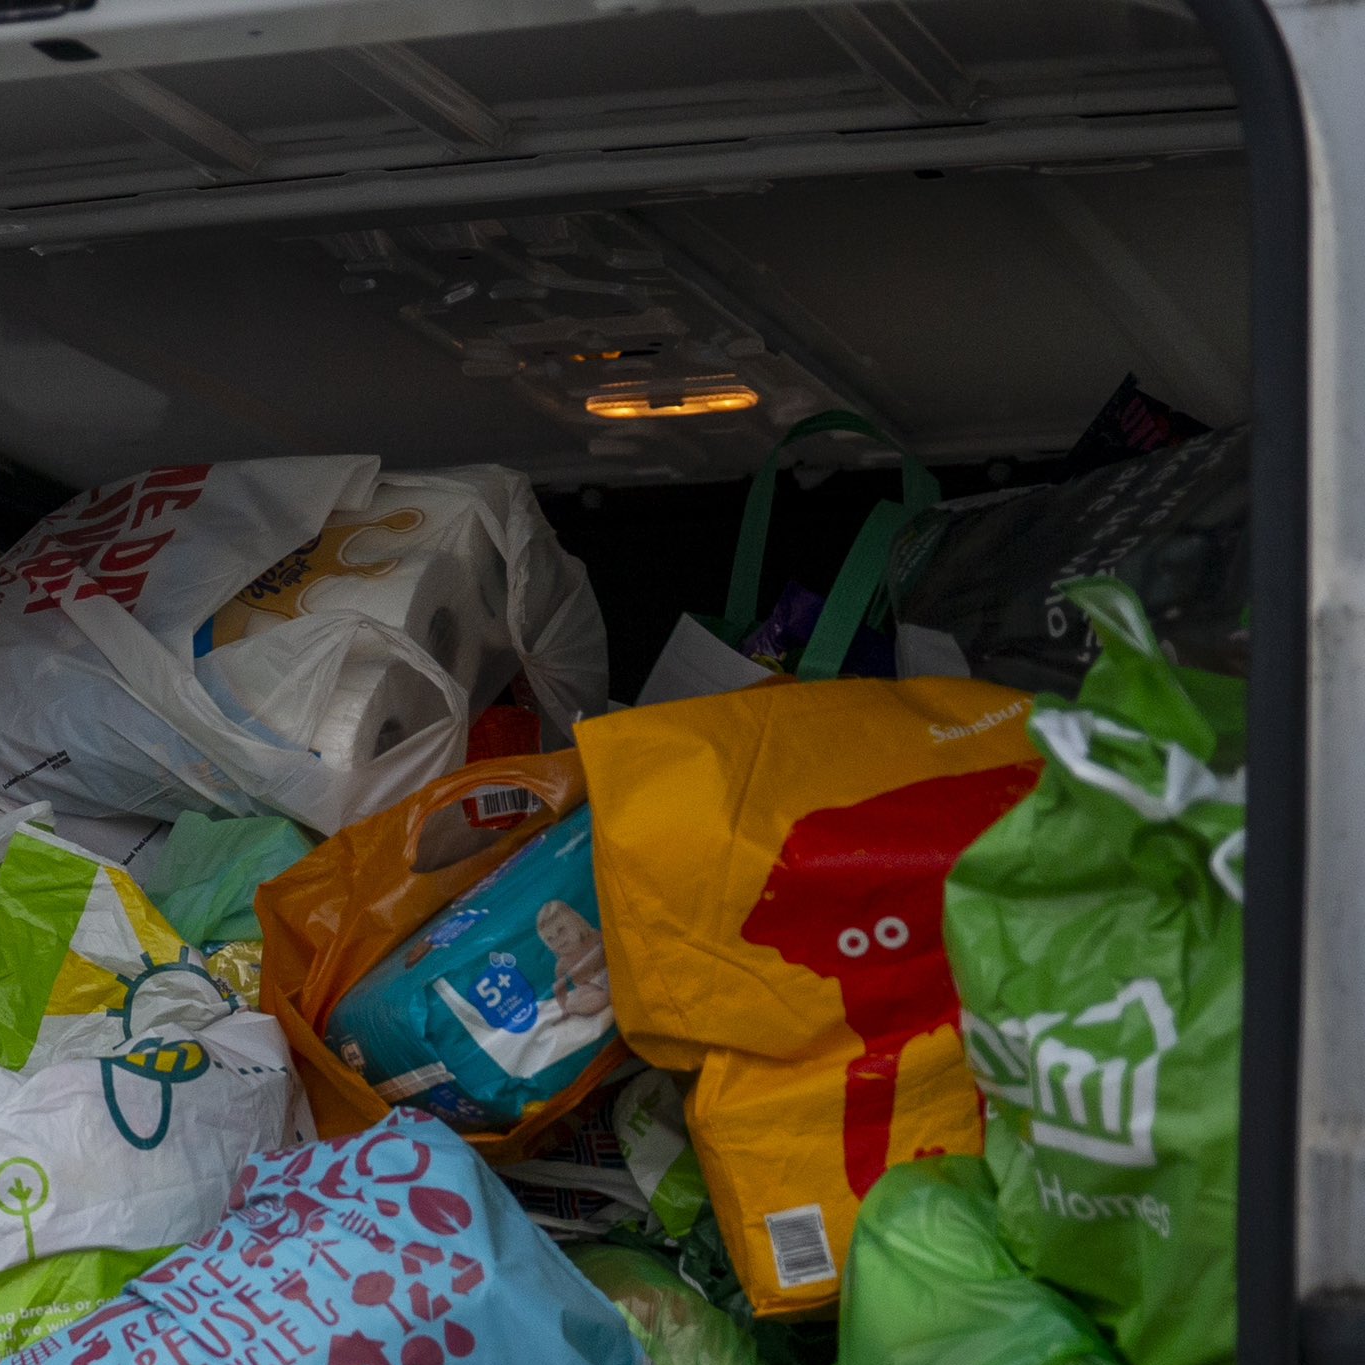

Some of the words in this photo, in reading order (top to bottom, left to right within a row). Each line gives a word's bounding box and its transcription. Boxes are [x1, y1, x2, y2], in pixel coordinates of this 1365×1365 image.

[19, 1301, 70, 1319] breaks
[74, 1300, 91, 1312] or
[121, 1255, 243, 1352] REUCE
[21, 1326, 42, 1338] we
